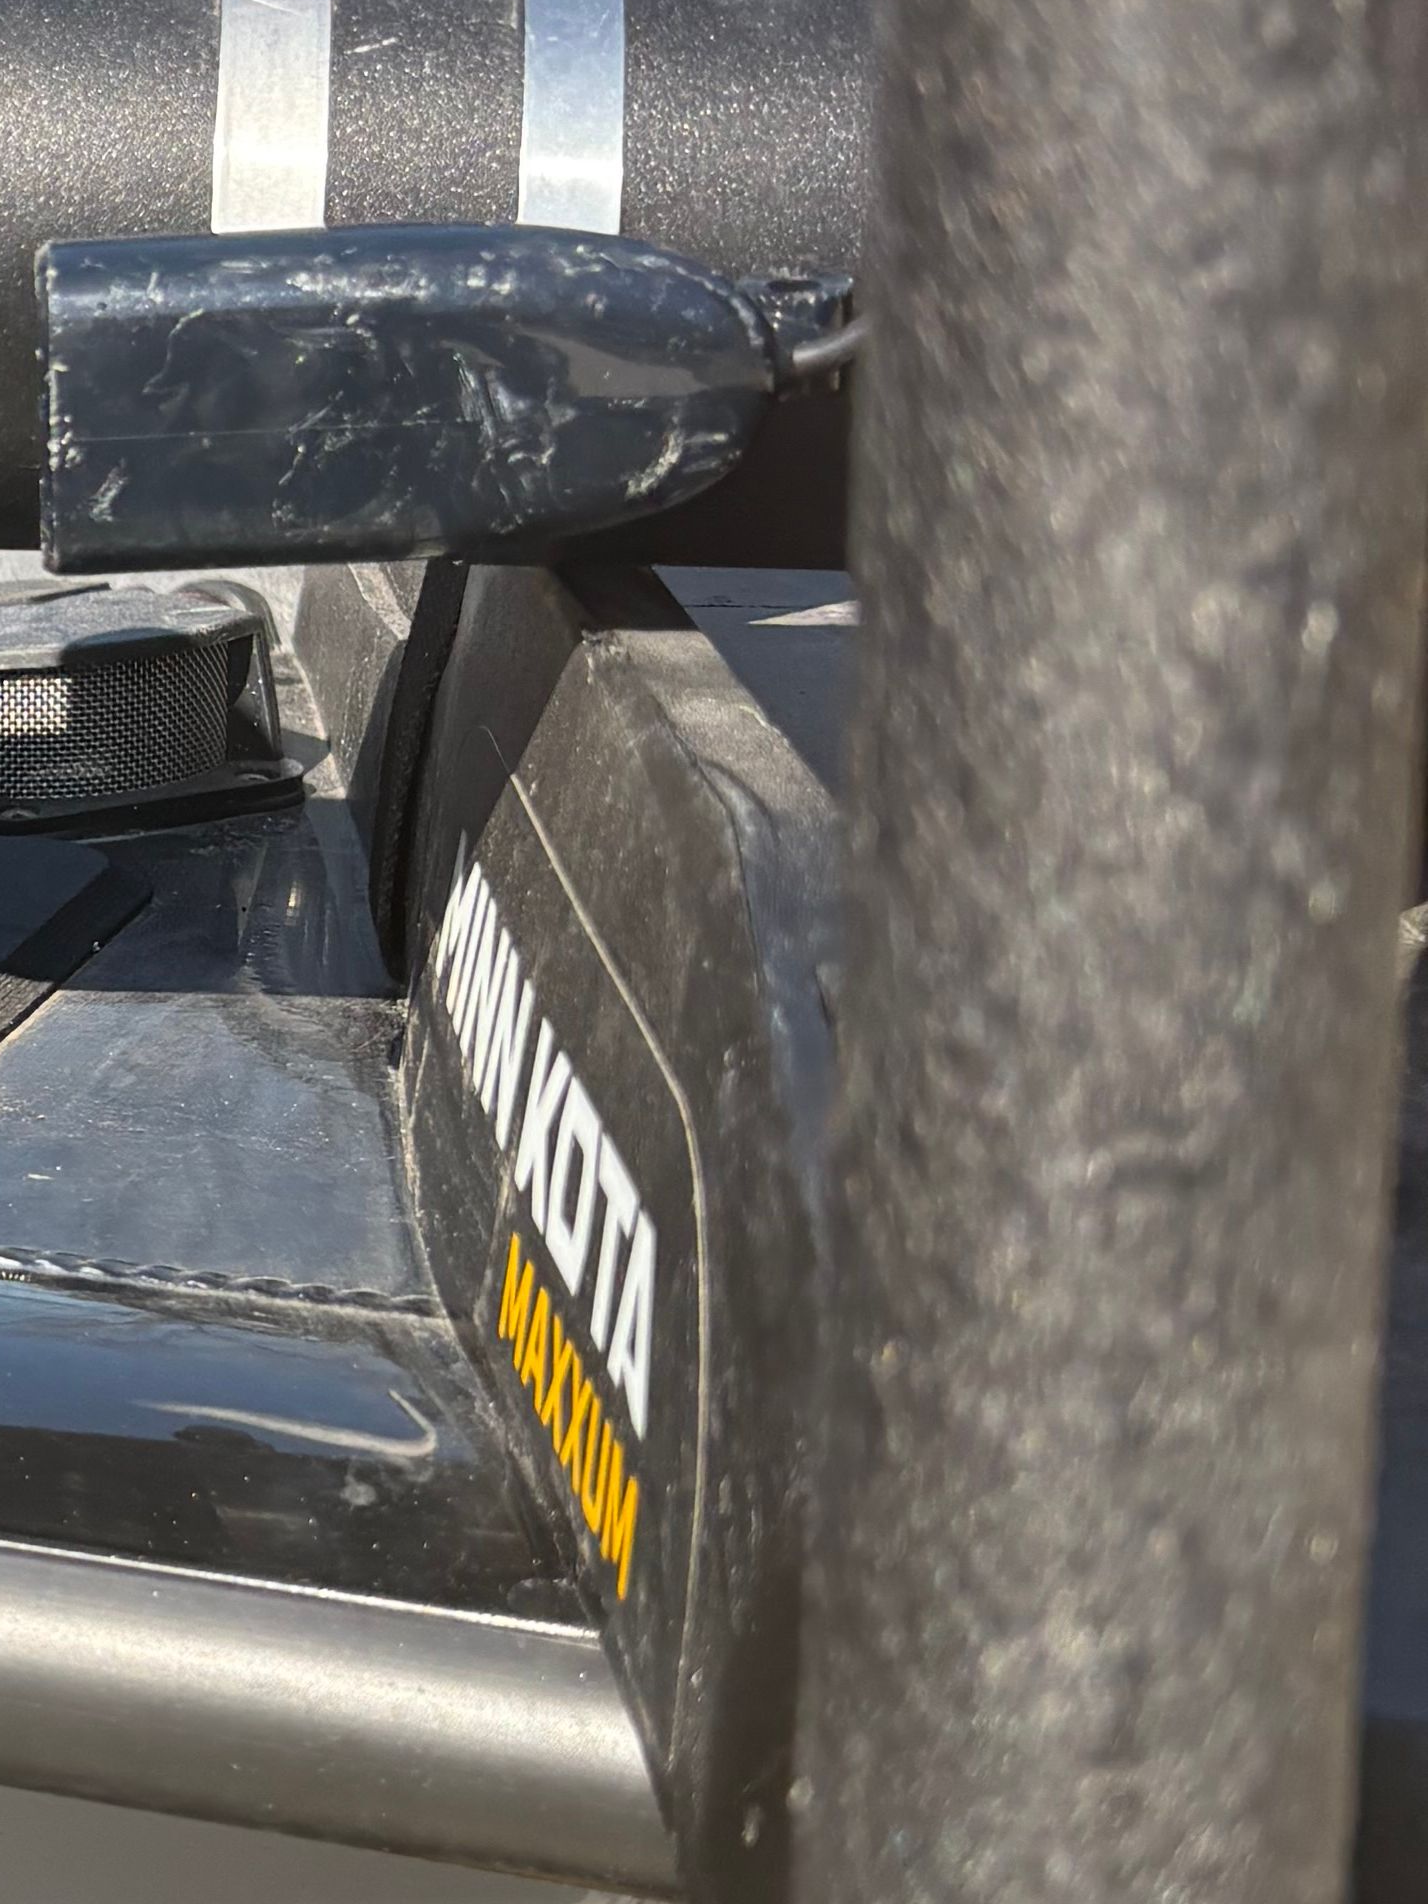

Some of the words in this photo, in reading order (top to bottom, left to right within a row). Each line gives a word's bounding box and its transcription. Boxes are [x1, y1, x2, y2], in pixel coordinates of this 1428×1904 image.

[435, 830, 535, 1152] MINN
[514, 1016, 657, 1441] KOTA
[497, 1230, 639, 1601] MAXXUM
